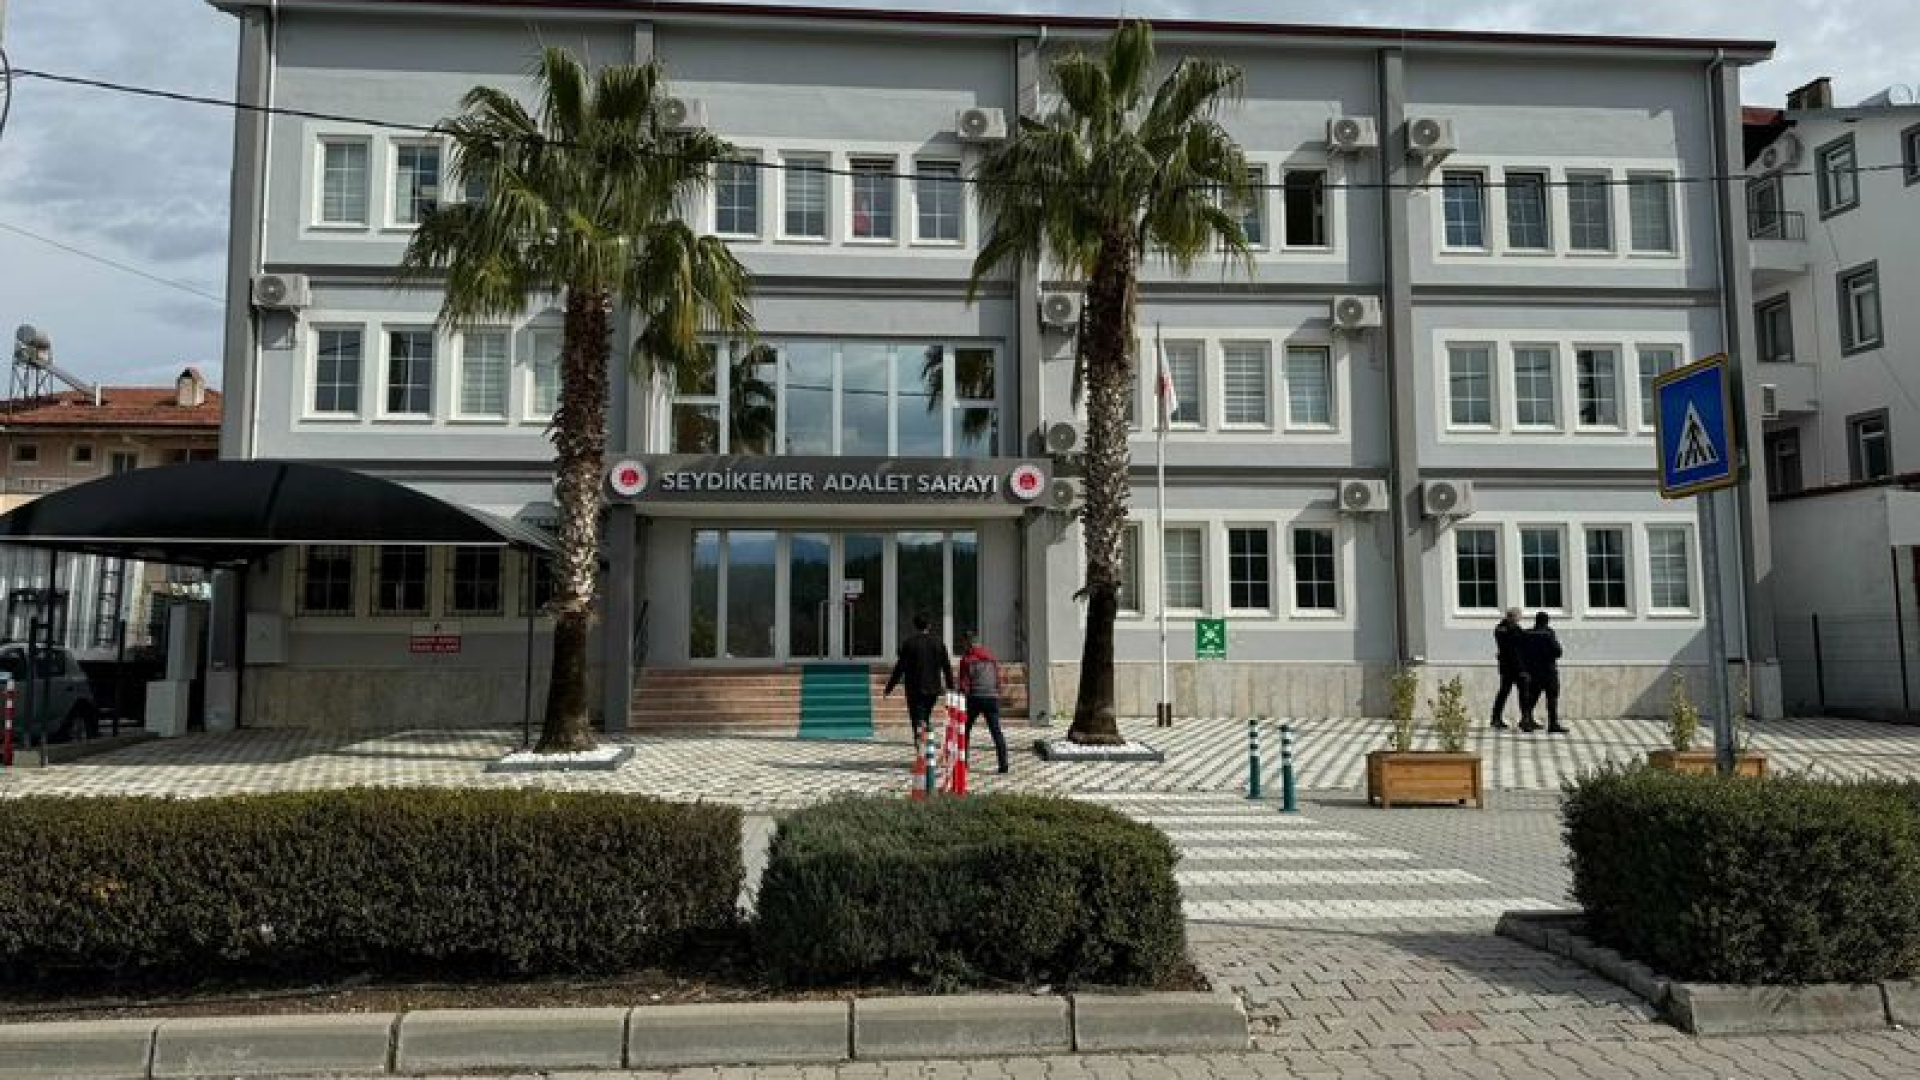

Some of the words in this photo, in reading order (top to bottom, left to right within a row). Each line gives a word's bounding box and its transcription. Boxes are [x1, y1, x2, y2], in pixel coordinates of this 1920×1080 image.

[661, 468, 815, 491] SEYDİKEMER
[823, 472, 912, 492] ADALET
[917, 474, 998, 493] SARAYI
